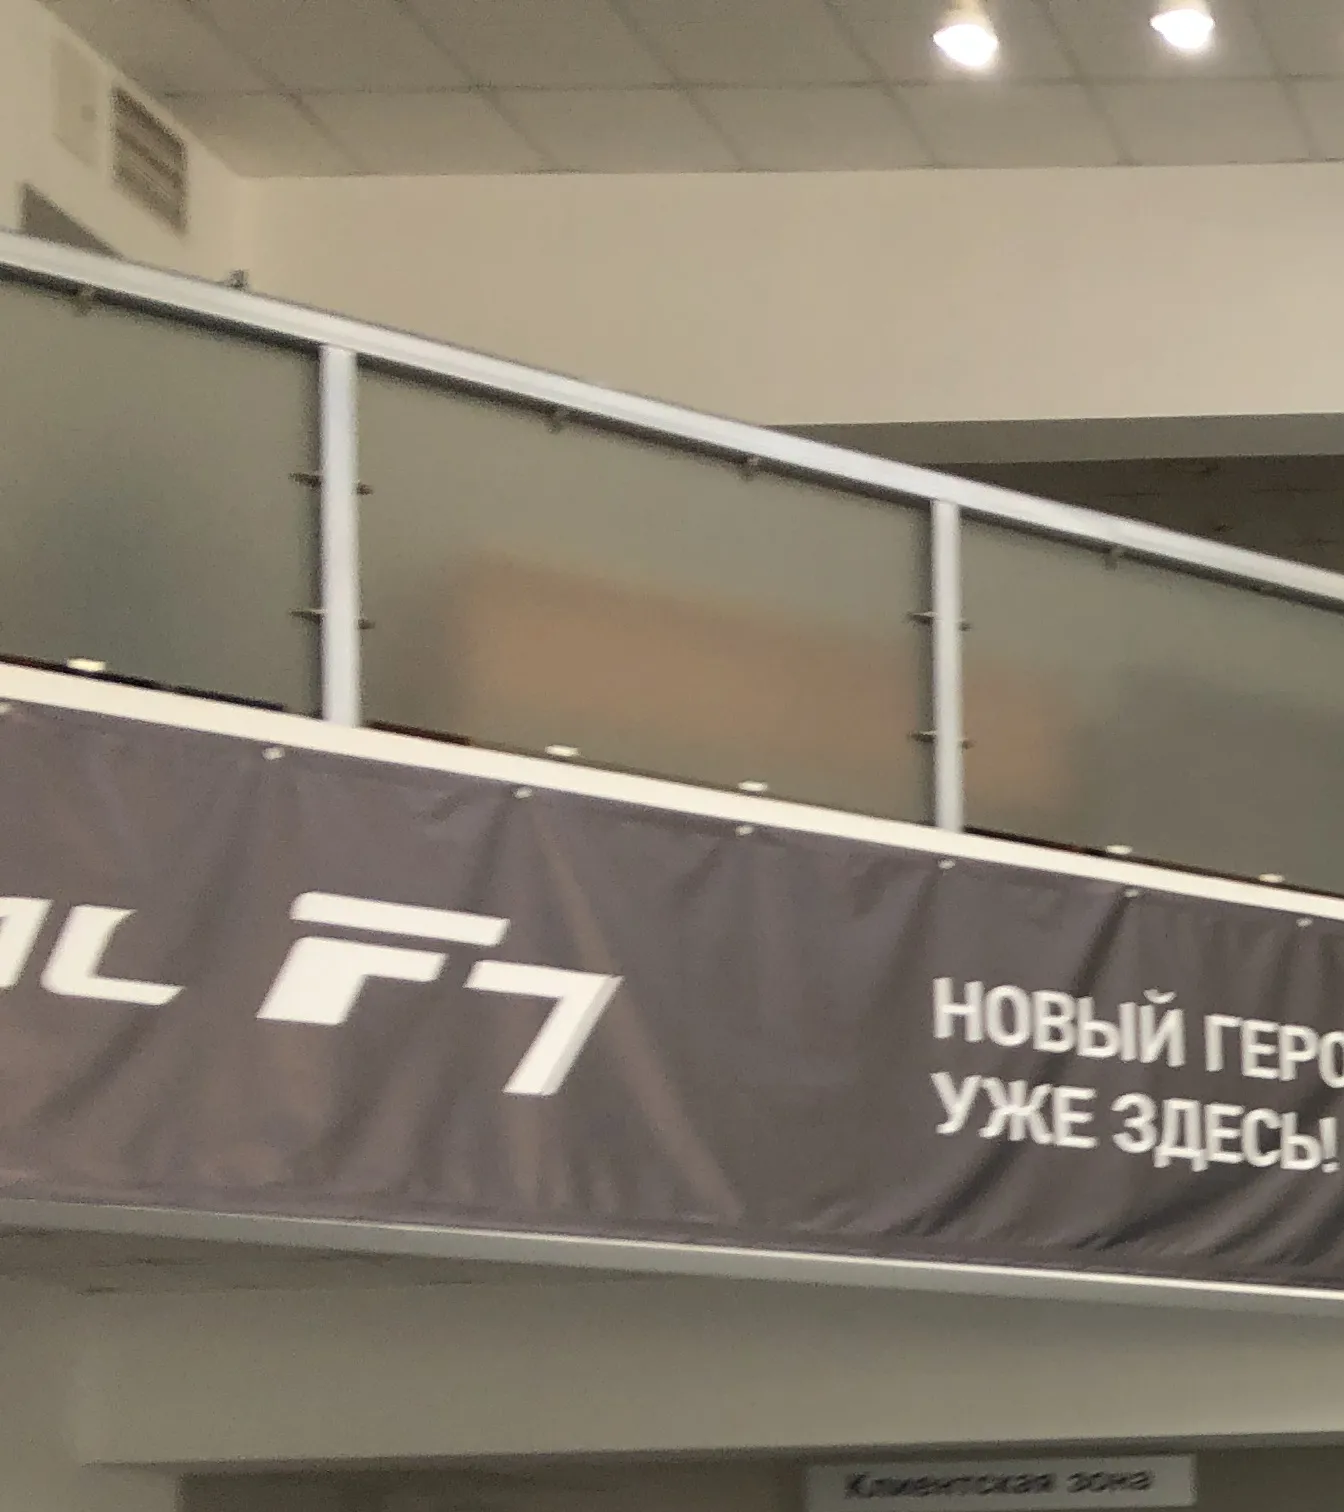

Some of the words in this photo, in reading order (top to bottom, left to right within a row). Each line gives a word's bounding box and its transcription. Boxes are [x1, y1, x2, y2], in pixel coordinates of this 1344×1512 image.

[256, 890, 626, 1098] F7
[931, 975, 1187, 1069] НОВЫЙ
[930, 1071, 1098, 1150] УЖЕ
[1110, 1092, 1341, 1174] ЗДЕСЬ!
[844, 1471, 1056, 1499] Клиентская
[1066, 1469, 1157, 1494] зона
